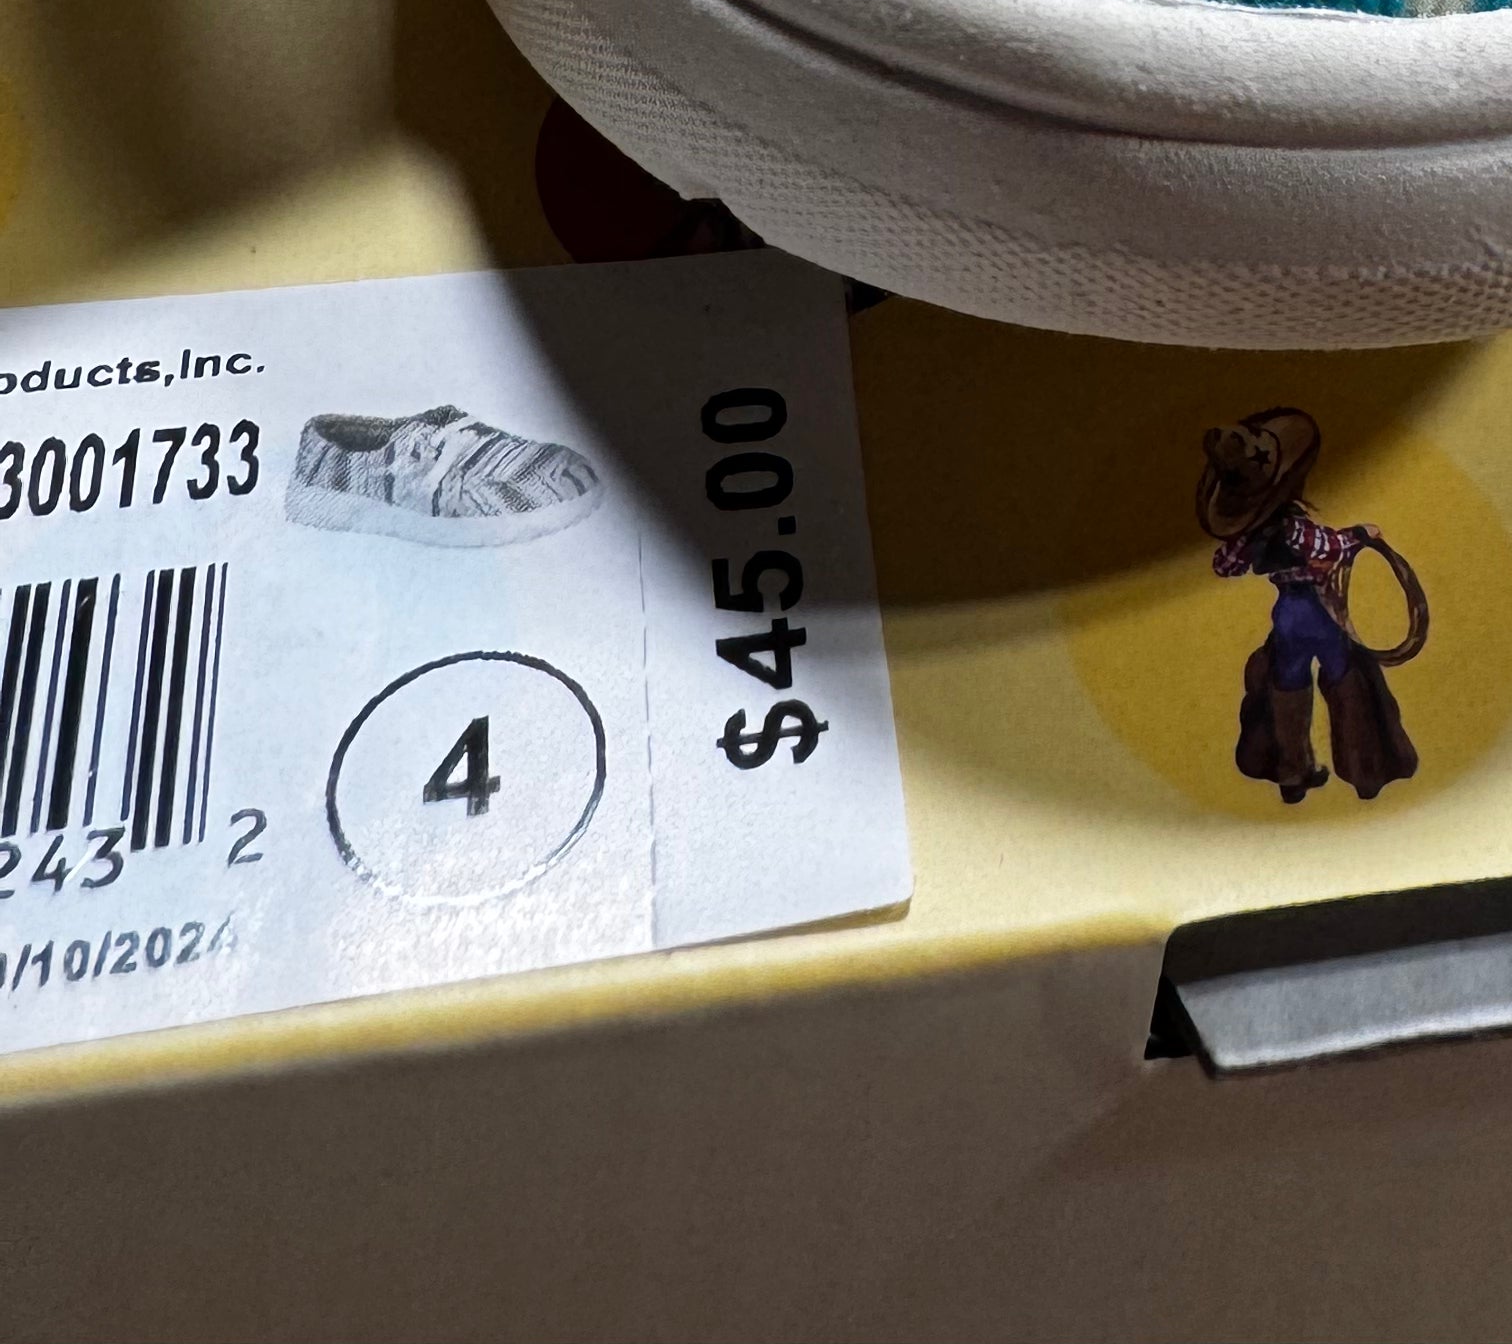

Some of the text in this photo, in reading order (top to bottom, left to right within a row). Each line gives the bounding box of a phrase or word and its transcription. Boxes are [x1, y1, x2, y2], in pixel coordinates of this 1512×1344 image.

[0, 418, 260, 520] 3001733
[701, 386, 829, 771] $45.00
[422, 714, 501, 818] 4
[227, 807, 268, 868] 2
